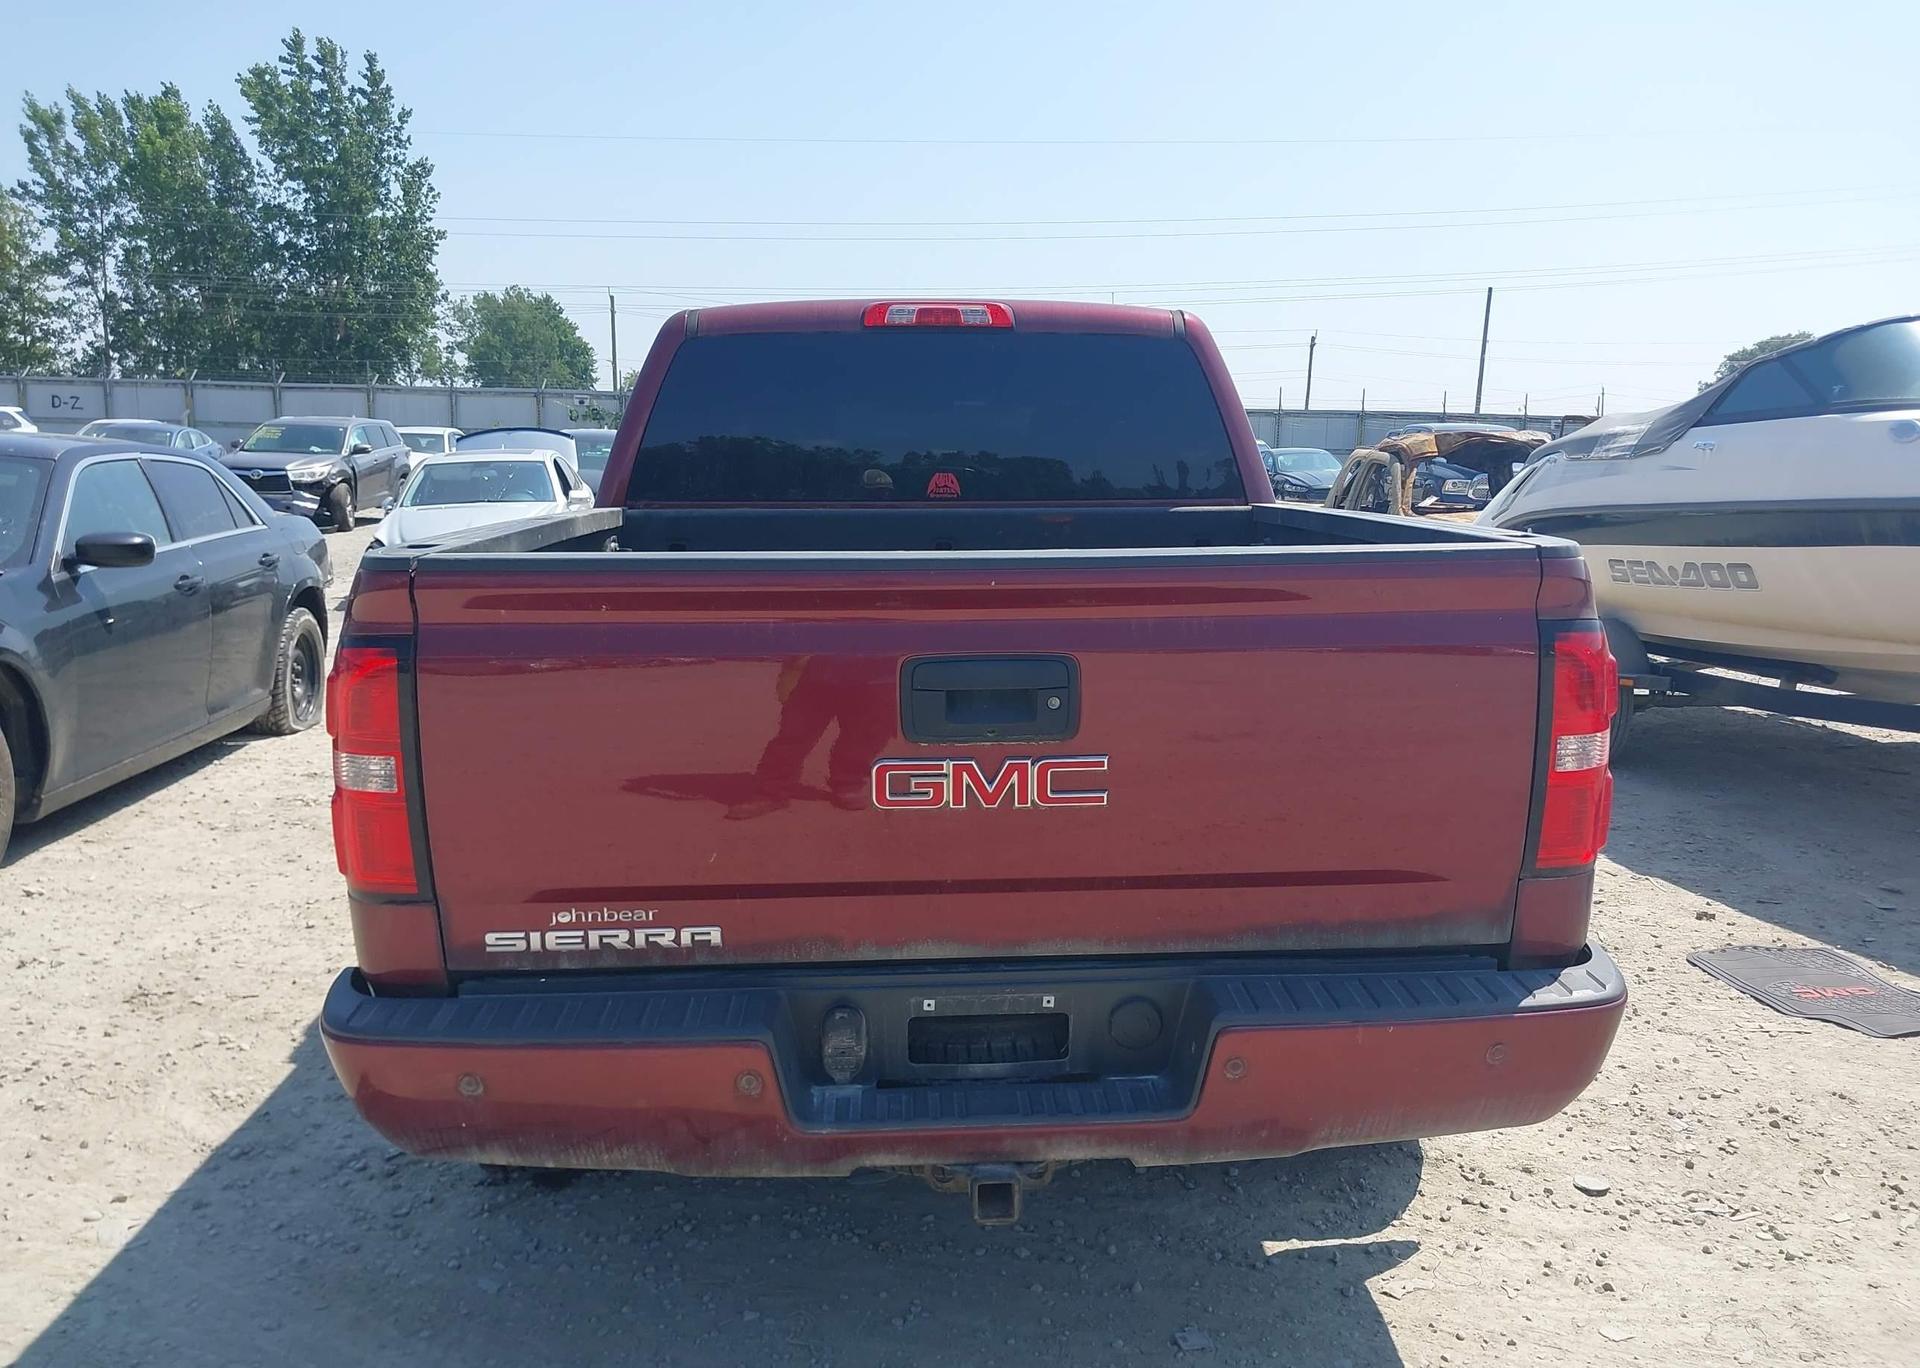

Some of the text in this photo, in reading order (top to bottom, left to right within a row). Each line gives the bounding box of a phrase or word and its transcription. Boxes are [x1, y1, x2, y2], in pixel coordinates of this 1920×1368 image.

[51, 394, 84, 410] D-Z
[872, 755, 1109, 809] GMC
[550, 907, 659, 926] johnbear
[484, 926, 722, 952] SIERRA
